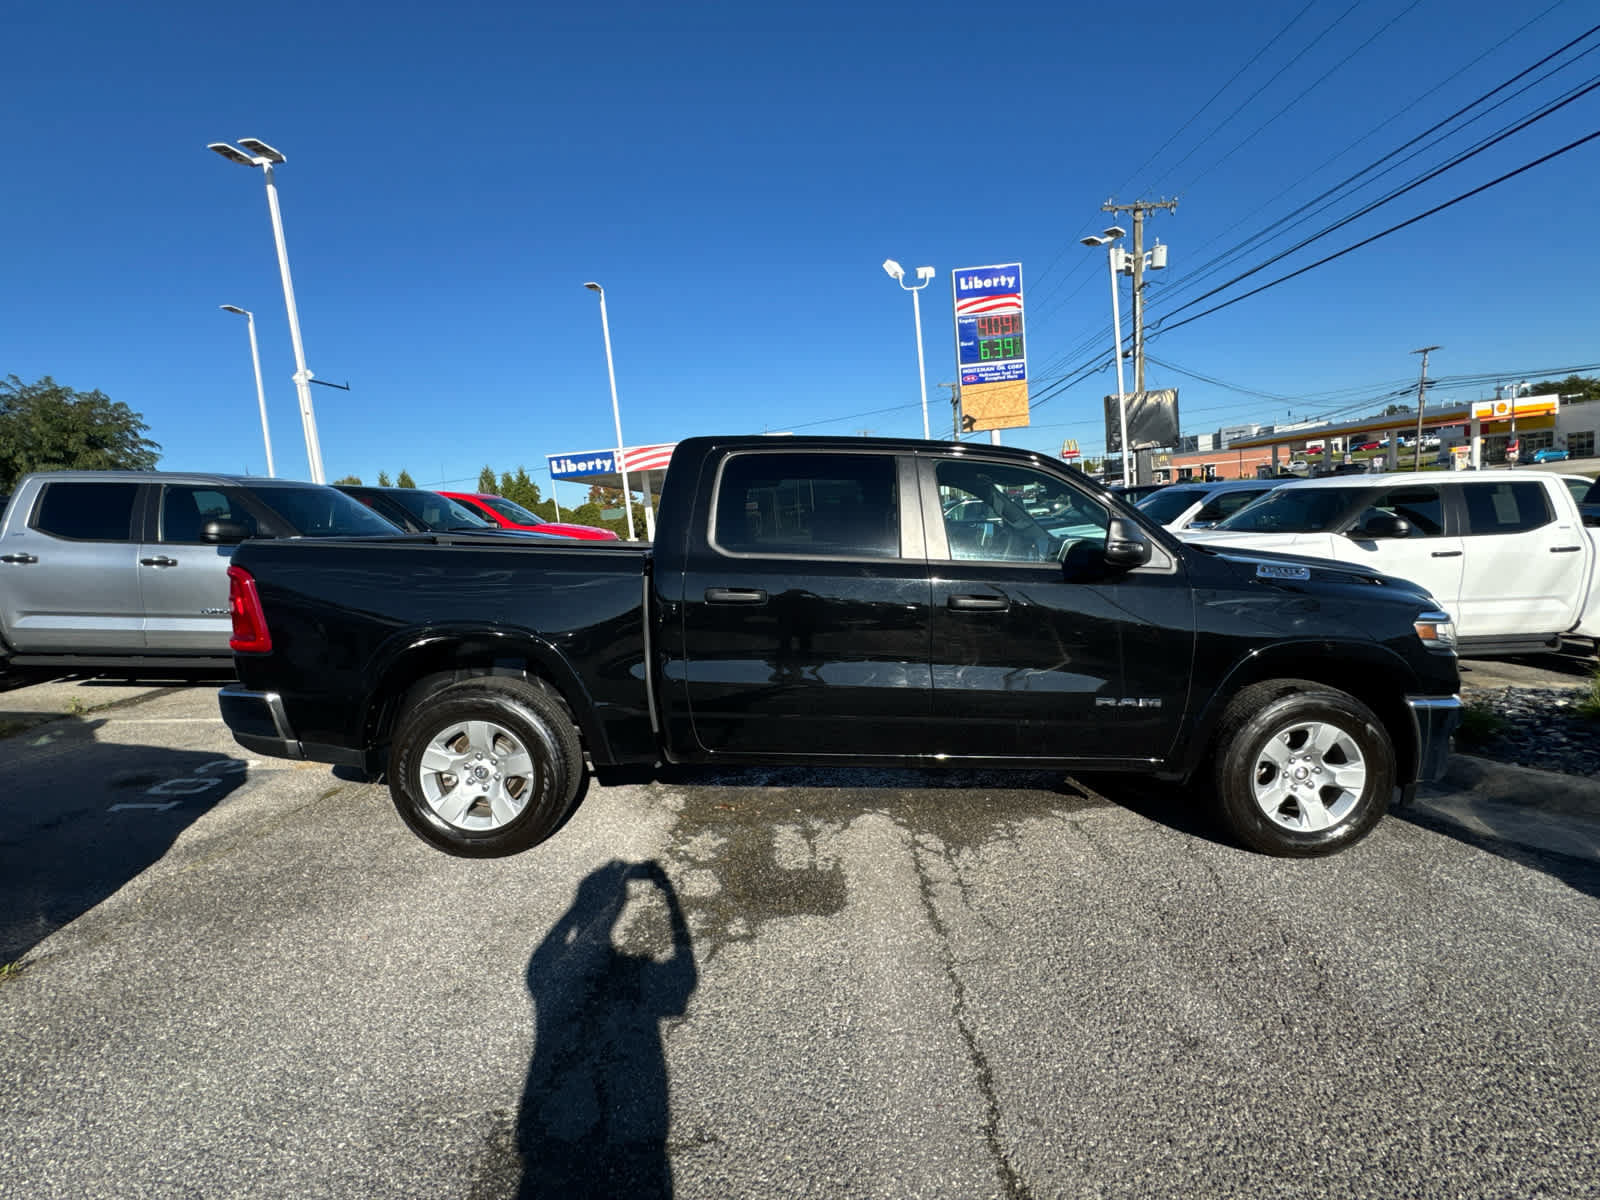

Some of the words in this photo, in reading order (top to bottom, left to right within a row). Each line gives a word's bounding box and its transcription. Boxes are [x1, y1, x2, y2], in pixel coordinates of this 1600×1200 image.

[960, 275, 1015, 290] Liberty
[551, 458, 613, 474] Liberty
[1095, 697, 1162, 708] RAM
